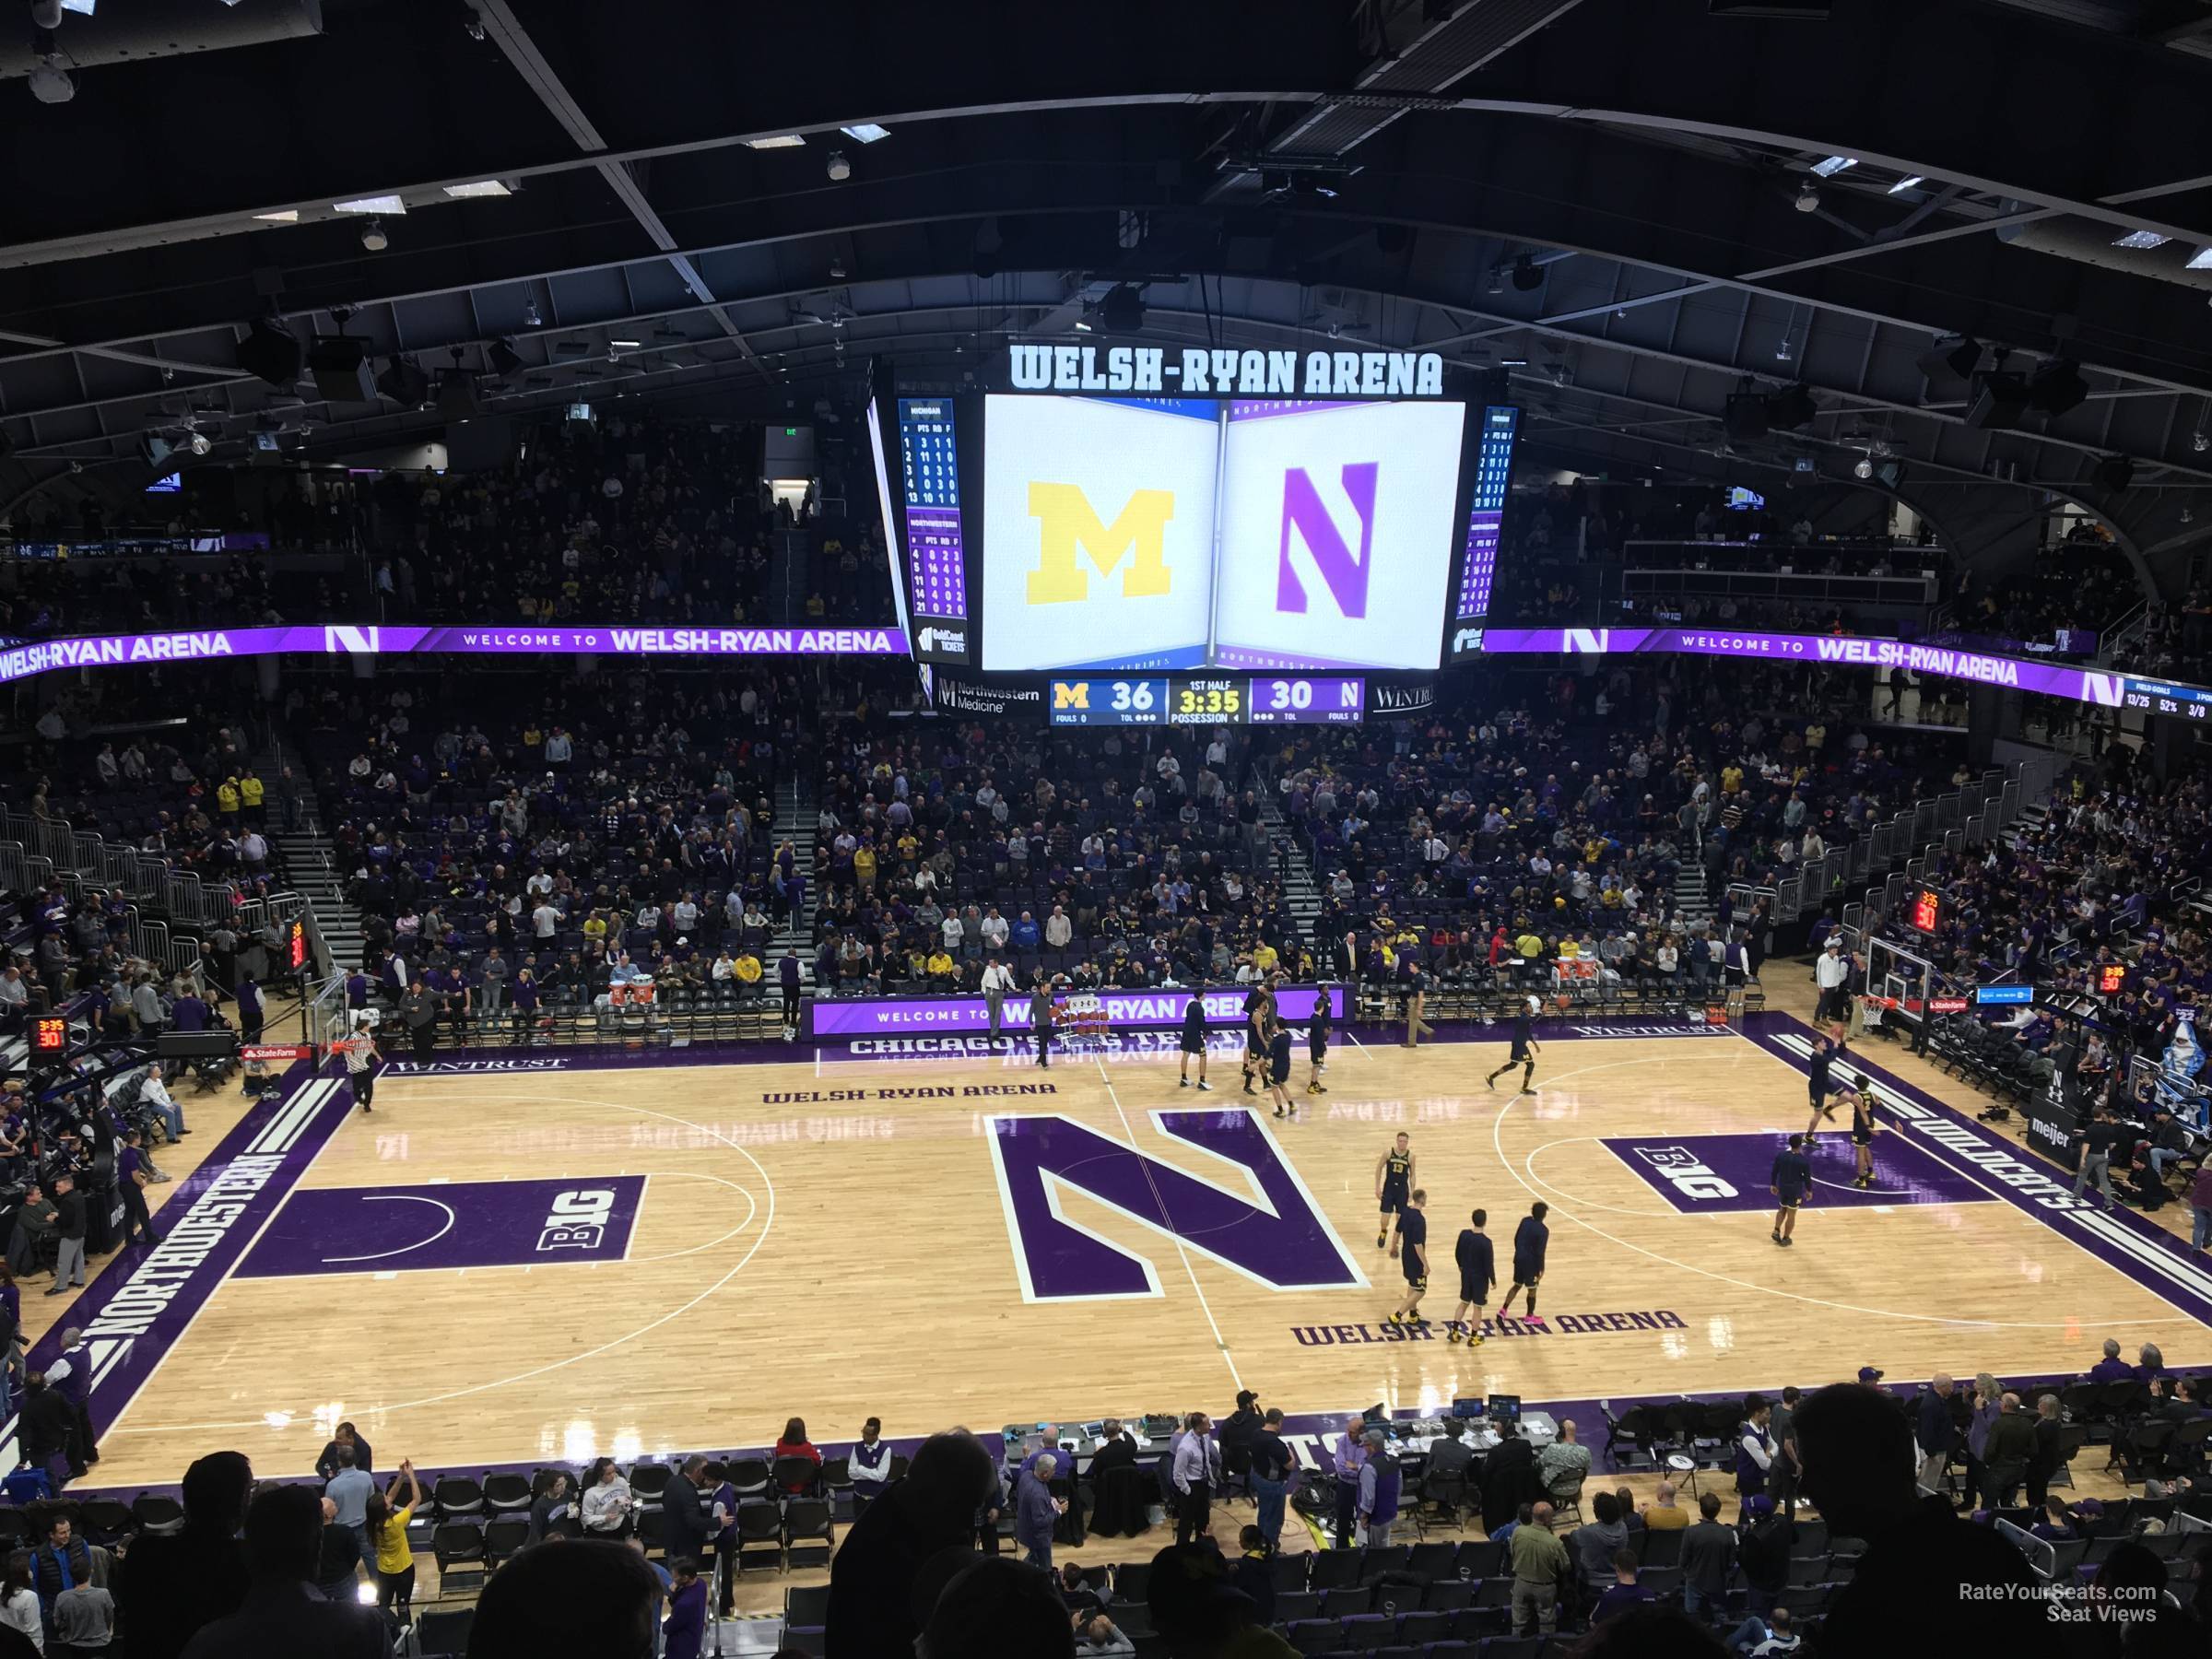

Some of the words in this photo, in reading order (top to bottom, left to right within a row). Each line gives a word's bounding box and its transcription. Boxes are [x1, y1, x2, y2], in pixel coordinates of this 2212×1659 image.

[1009, 345, 1297, 394] WELSH-RYAN
[1304, 350, 1443, 395] ARENA
[910, 406, 941, 416] MICHIGAN
[917, 424, 930, 432] PTS
[932, 424, 942, 432] RB
[904, 437, 910, 448] 1
[921, 437, 927, 448] 3
[935, 437, 940, 448] 1
[946, 438, 951, 448] 1
[905, 451, 912, 462] 2
[920, 452, 930, 462] 11
[935, 452, 941, 462] 1
[947, 452, 953, 463] 0
[906, 465, 912, 476] 3
[924, 465, 930, 476] 8
[936, 465, 943, 477] 3
[947, 465, 953, 477] 1
[907, 478, 913, 489] 4
[924, 479, 931, 489] 0
[937, 479, 944, 489] 3
[948, 479, 955, 490] 0
[908, 492, 918, 502] 13
[924, 492, 933, 503] 10
[938, 493, 944, 503] 1
[950, 493, 956, 504] 0
[910, 519, 959, 528] NORTHWESTERN
[925, 536, 937, 545] PTS
[953, 537, 959, 546] F
[1027, 481, 1175, 606] M
[1276, 461, 1380, 620] N
[912, 548, 919, 559] 4
[929, 549, 935, 560] 8
[942, 550, 948, 561] 2
[954, 551, 959, 561] 3
[913, 562, 920, 572] 5
[928, 563, 938, 573] 16
[943, 563, 949, 574] 4
[954, 564, 960, 575] 0
[914, 575, 924, 585] 11
[931, 576, 937, 586] 0
[944, 577, 950, 588] 3
[956, 578, 960, 588] 1
[915, 589, 924, 599] 14
[932, 590, 938, 600] 4
[945, 591, 952, 601] 0
[956, 592, 962, 602] 2
[916, 602, 925, 612] 21
[933, 603, 939, 613] 0
[946, 604, 952, 614] 2
[958, 605, 963, 615] 0
[324, 626, 380, 653] N
[463, 633, 562, 646] WELCOME
[573, 634, 597, 646] TO
[609, 629, 793, 653] WELSH-RYAN
[798, 630, 892, 652] ARENA
[1563, 629, 1608, 653] N
[941, 641, 966, 653] TICKETS
[0, 639, 123, 680] WELSH-RYAN
[130, 632, 232, 661] ARENA
[1682, 635, 1771, 652] WELCOME
[1782, 641, 1804, 653] TO
[1817, 638, 1955, 674] WELSH-RYAN
[1956, 657, 2018, 686] ARENA
[958, 681, 1040, 701] Northwestern
[1189, 680, 1206, 691] 1ST
[1207, 680, 1231, 691] HALF
[2081, 672, 2124, 708] N
[2136, 683, 2152, 692] FIELD
[2152, 685, 2171, 695] GOALS
[1053, 682, 1090, 709] M
[1111, 681, 1153, 711] 36
[1180, 690, 1240, 713] 3:35
[1269, 680, 1313, 710] 30
[1341, 682, 1359, 707] N
[2126, 693, 2150, 708] 13/25
[2159, 699, 2178, 712] 52%
[2188, 704, 2206, 718] 3/8
[1056, 714, 1077, 723] FOULS
[1080, 714, 1087, 724] 0
[1120, 713, 1134, 722] TOL
[1171, 713, 1229, 724] POSSESSION
[1284, 712, 1297, 721] TOL
[1328, 712, 1348, 721] FOULS
[1352, 712, 1359, 722] 0
[1921, 891, 1938, 908] 3:35
[1917, 902, 1936, 930] 30
[2101, 977, 2119, 991] 30
[877, 1010, 959, 1022] WELCOME
[970, 1009, 989, 1019] TO
[40, 1019, 64, 1031] 3:35
[1571, 1026, 1722, 1035] WINTRUST
[40, 1032, 60, 1047] 30
[850, 1035, 1047, 1054] CHICAGO'S
[395, 1058, 570, 1072] WINTRUST
[2053, 1069, 2063, 1088] N
[762, 1086, 955, 1104] WELSH-RYAN
[963, 1083, 1058, 1096] ARENA
[2031, 1117, 2070, 1147] meijer
[1911, 1118, 2095, 1209] WILDCATS
[983, 1107, 1372, 1304] N
[79, 1154, 288, 1337] NORTHWESTERN
[1556, 1311, 1689, 1334] ARENA
